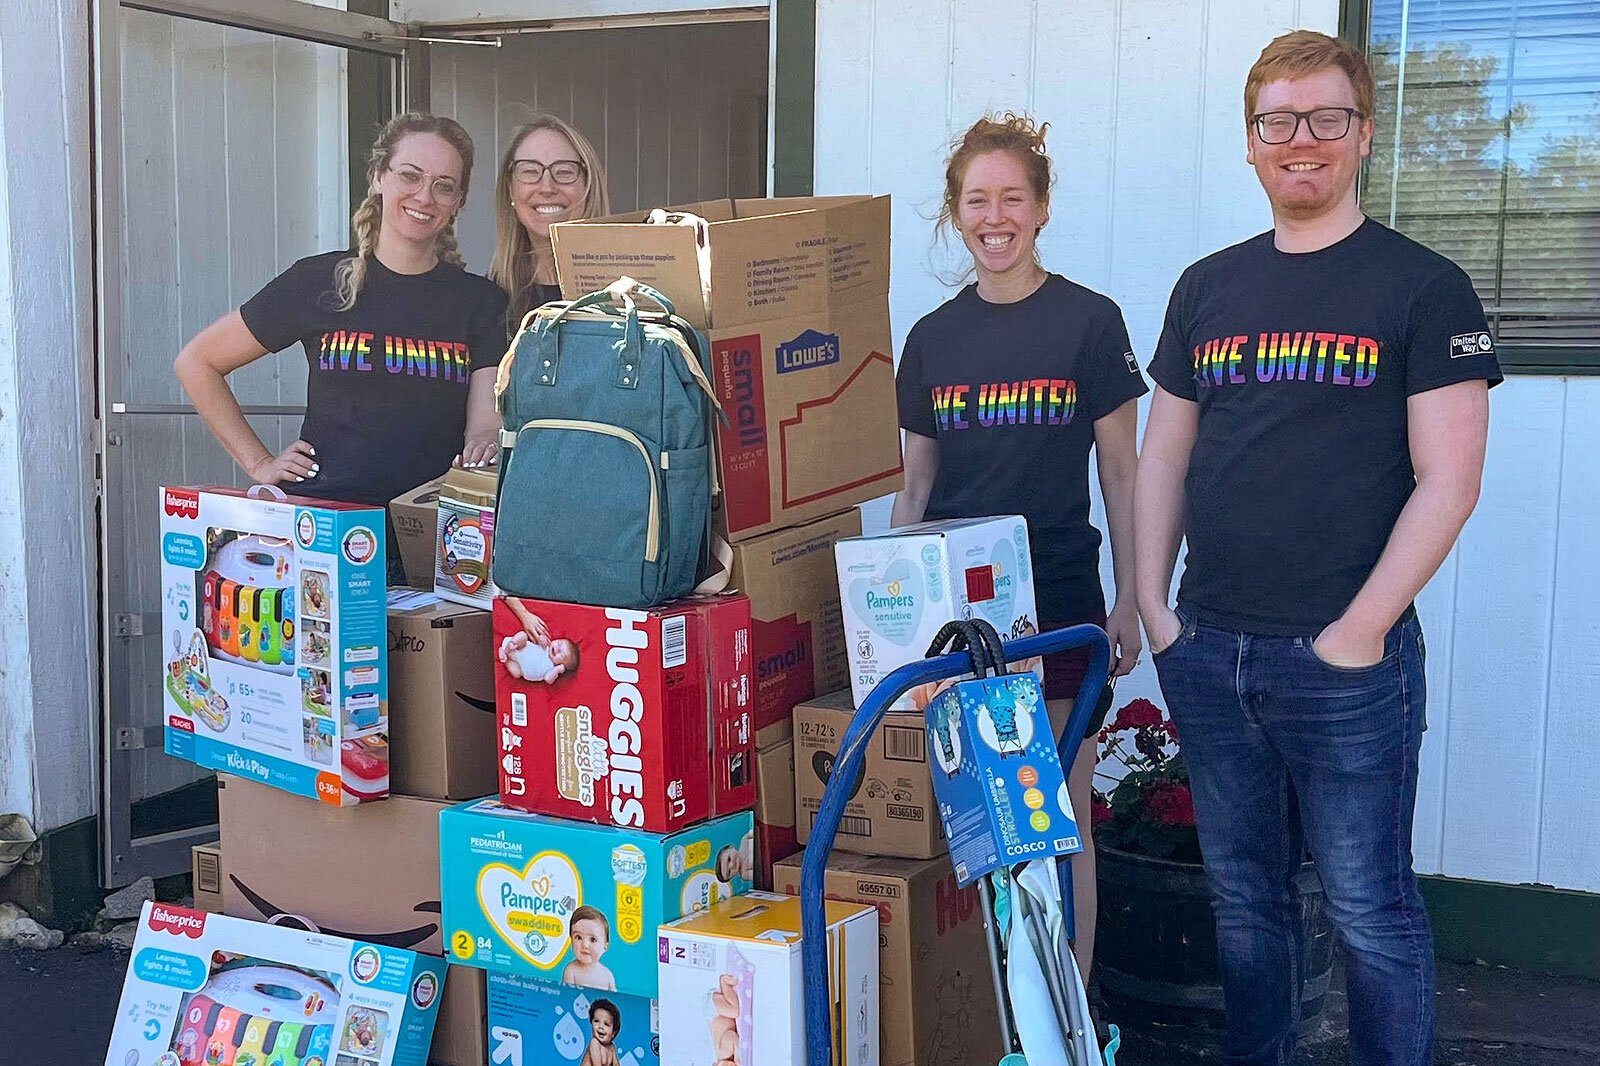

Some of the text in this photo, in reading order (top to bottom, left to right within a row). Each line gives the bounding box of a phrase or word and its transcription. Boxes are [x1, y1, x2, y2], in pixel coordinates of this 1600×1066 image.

[1452, 335, 1476, 347] United
[782, 341, 835, 369] LOWE'S
[1461, 344, 1477, 355] Way
[385, 335, 471, 385] UNITE
[1256, 332, 1380, 387] UNITED
[732, 347, 764, 448] small
[977, 379, 1078, 428] UNITED
[453, 535, 483, 551] Sensitivity
[866, 591, 914, 610] Pampers
[875, 611, 912, 621] sensitive
[757, 638, 806, 679] small
[858, 675, 875, 686] 576
[239, 683, 255, 696] 65+
[171, 718, 193, 730] TEACHES
[241, 711, 252, 725] 20
[604, 606, 650, 828] HUGGIES
[800, 722, 836, 738] 12-72's
[576, 708, 593, 805] snugglers
[513, 755, 522, 775] 128
[510, 777, 527, 796] n
[676, 779, 684, 798] 128
[985, 766, 1001, 806] UMBRELLA
[997, 787, 1021, 846] STROLLER
[995, 806, 1012, 847] DINOSAUR
[470, 837, 523, 852] PEDIATRICIAN
[1006, 841, 1048, 857] COSCO
[612, 858, 647, 871] SOFTEST
[859, 883, 898, 896] 49557 01
[500, 881, 566, 916] Pampers
[507, 915, 562, 934] swaddlers
[458, 934, 468, 950] 2
[477, 936, 493, 950] 84
[155, 952, 188, 967] Learning,
[675, 947, 686, 958] N
[143, 959, 164, 971] lights
[170, 966, 193, 977] music
[522, 982, 540, 993] baby
[540, 986, 561, 996] wipes
[146, 1000, 173, 1013] Try Me!
